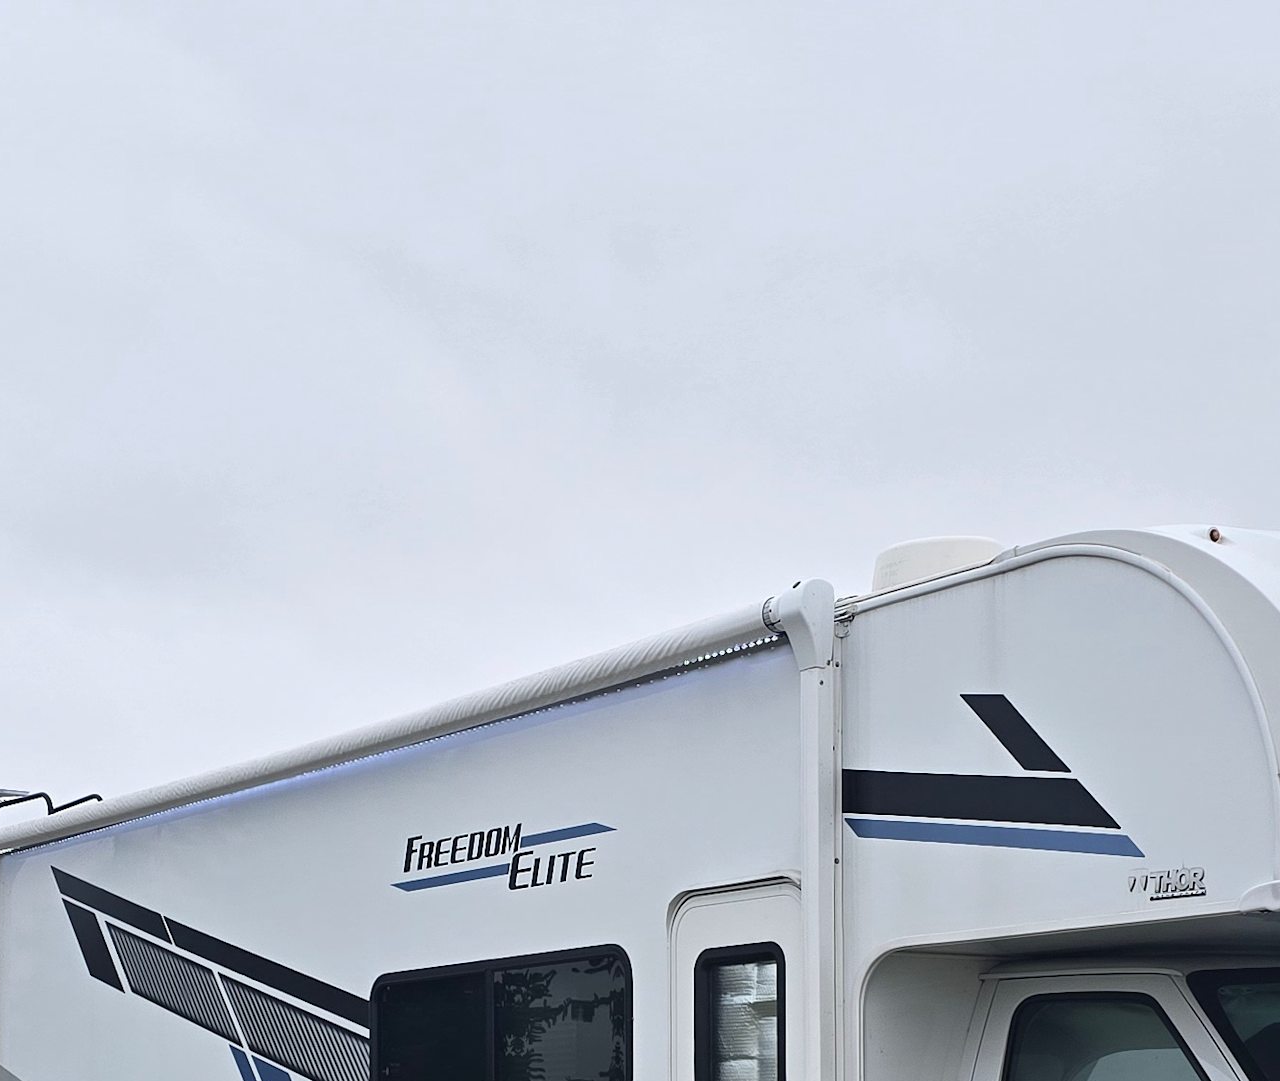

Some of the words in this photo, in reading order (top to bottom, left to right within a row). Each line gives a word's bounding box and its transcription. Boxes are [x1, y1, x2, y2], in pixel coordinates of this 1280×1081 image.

[403, 823, 522, 873] FREEDOM
[508, 847, 597, 891] ELITE
[1149, 867, 1206, 894] THOR
